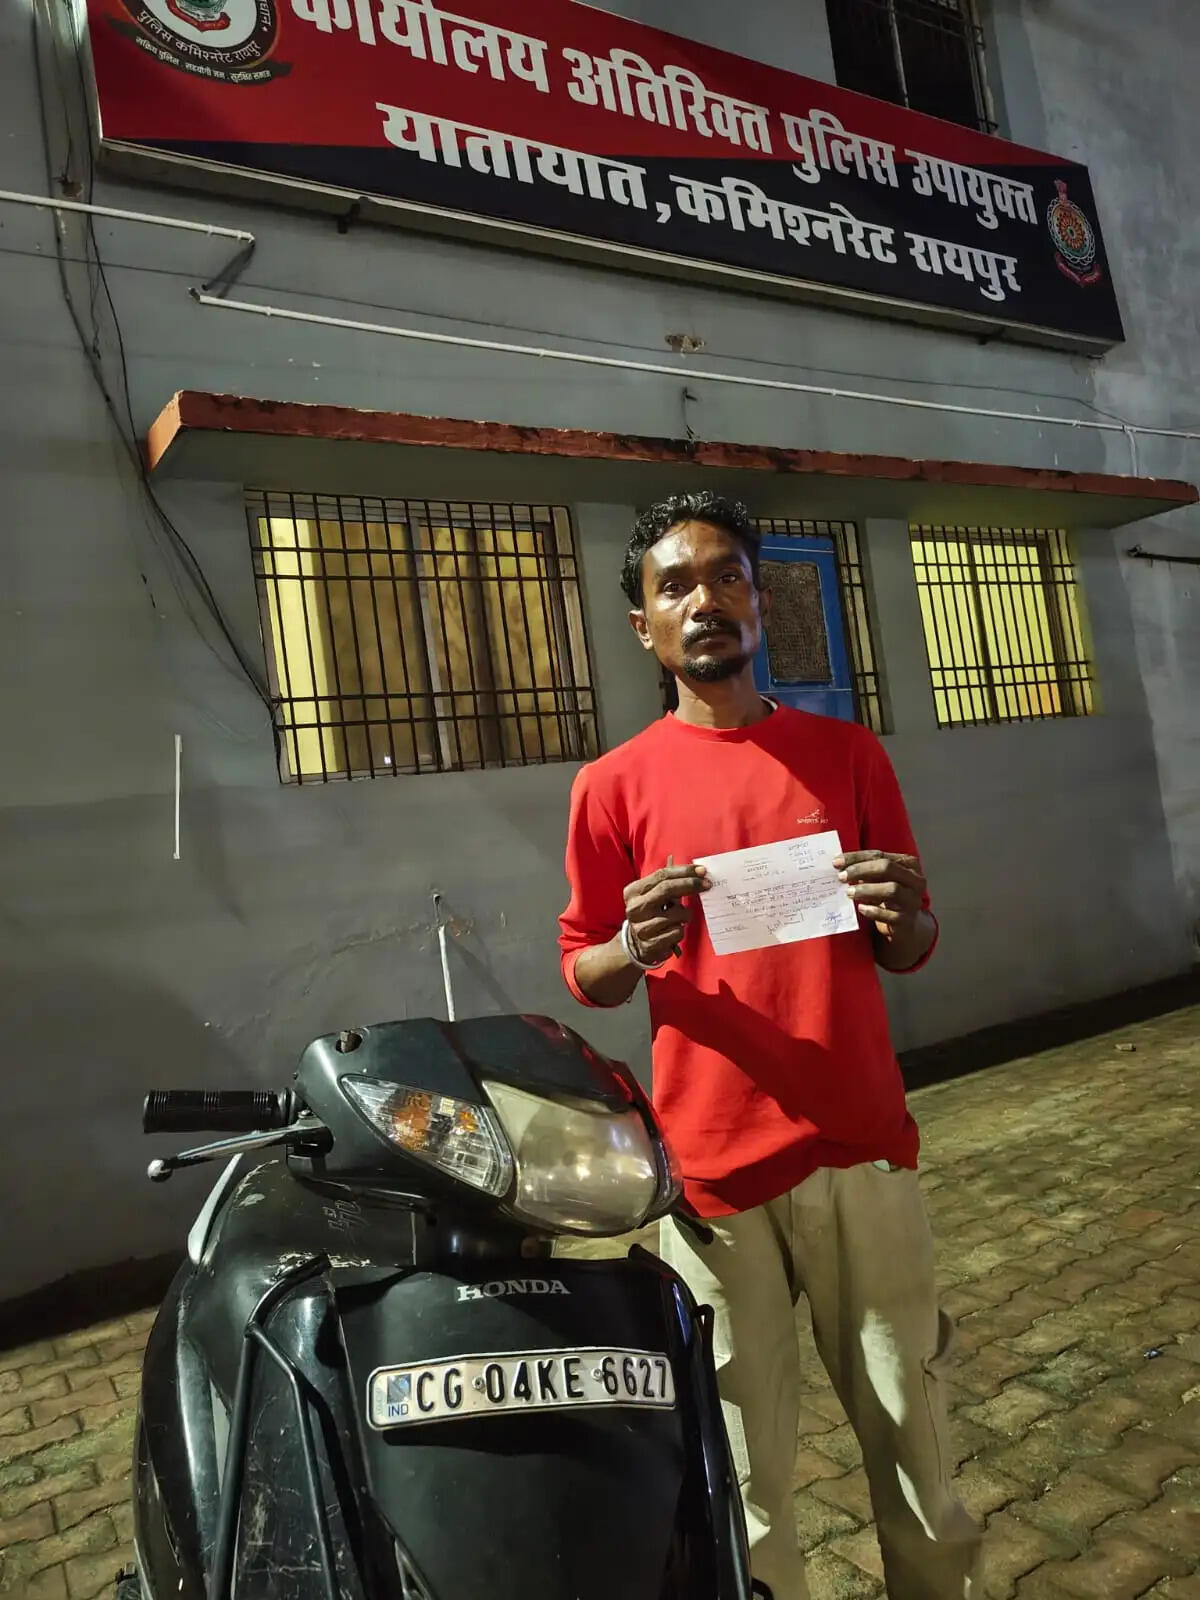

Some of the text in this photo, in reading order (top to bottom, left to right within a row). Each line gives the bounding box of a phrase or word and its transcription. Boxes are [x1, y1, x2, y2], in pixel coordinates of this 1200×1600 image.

[136, 10, 261, 63] पुलिस कमिश्नरेट रायपुर
[563, 48, 771, 154] अतिरिक्त
[780, 109, 898, 187] पुलिस
[905, 149, 1037, 229] उपायुक्त
[904, 232, 1021, 301] रायपुर
[457, 1279, 571, 1302] HONDA
[387, 1403, 409, 1418] IND
[417, 1367, 463, 1412] CG
[485, 1357, 584, 1404] 04KE
[602, 1355, 667, 1398] 6627
